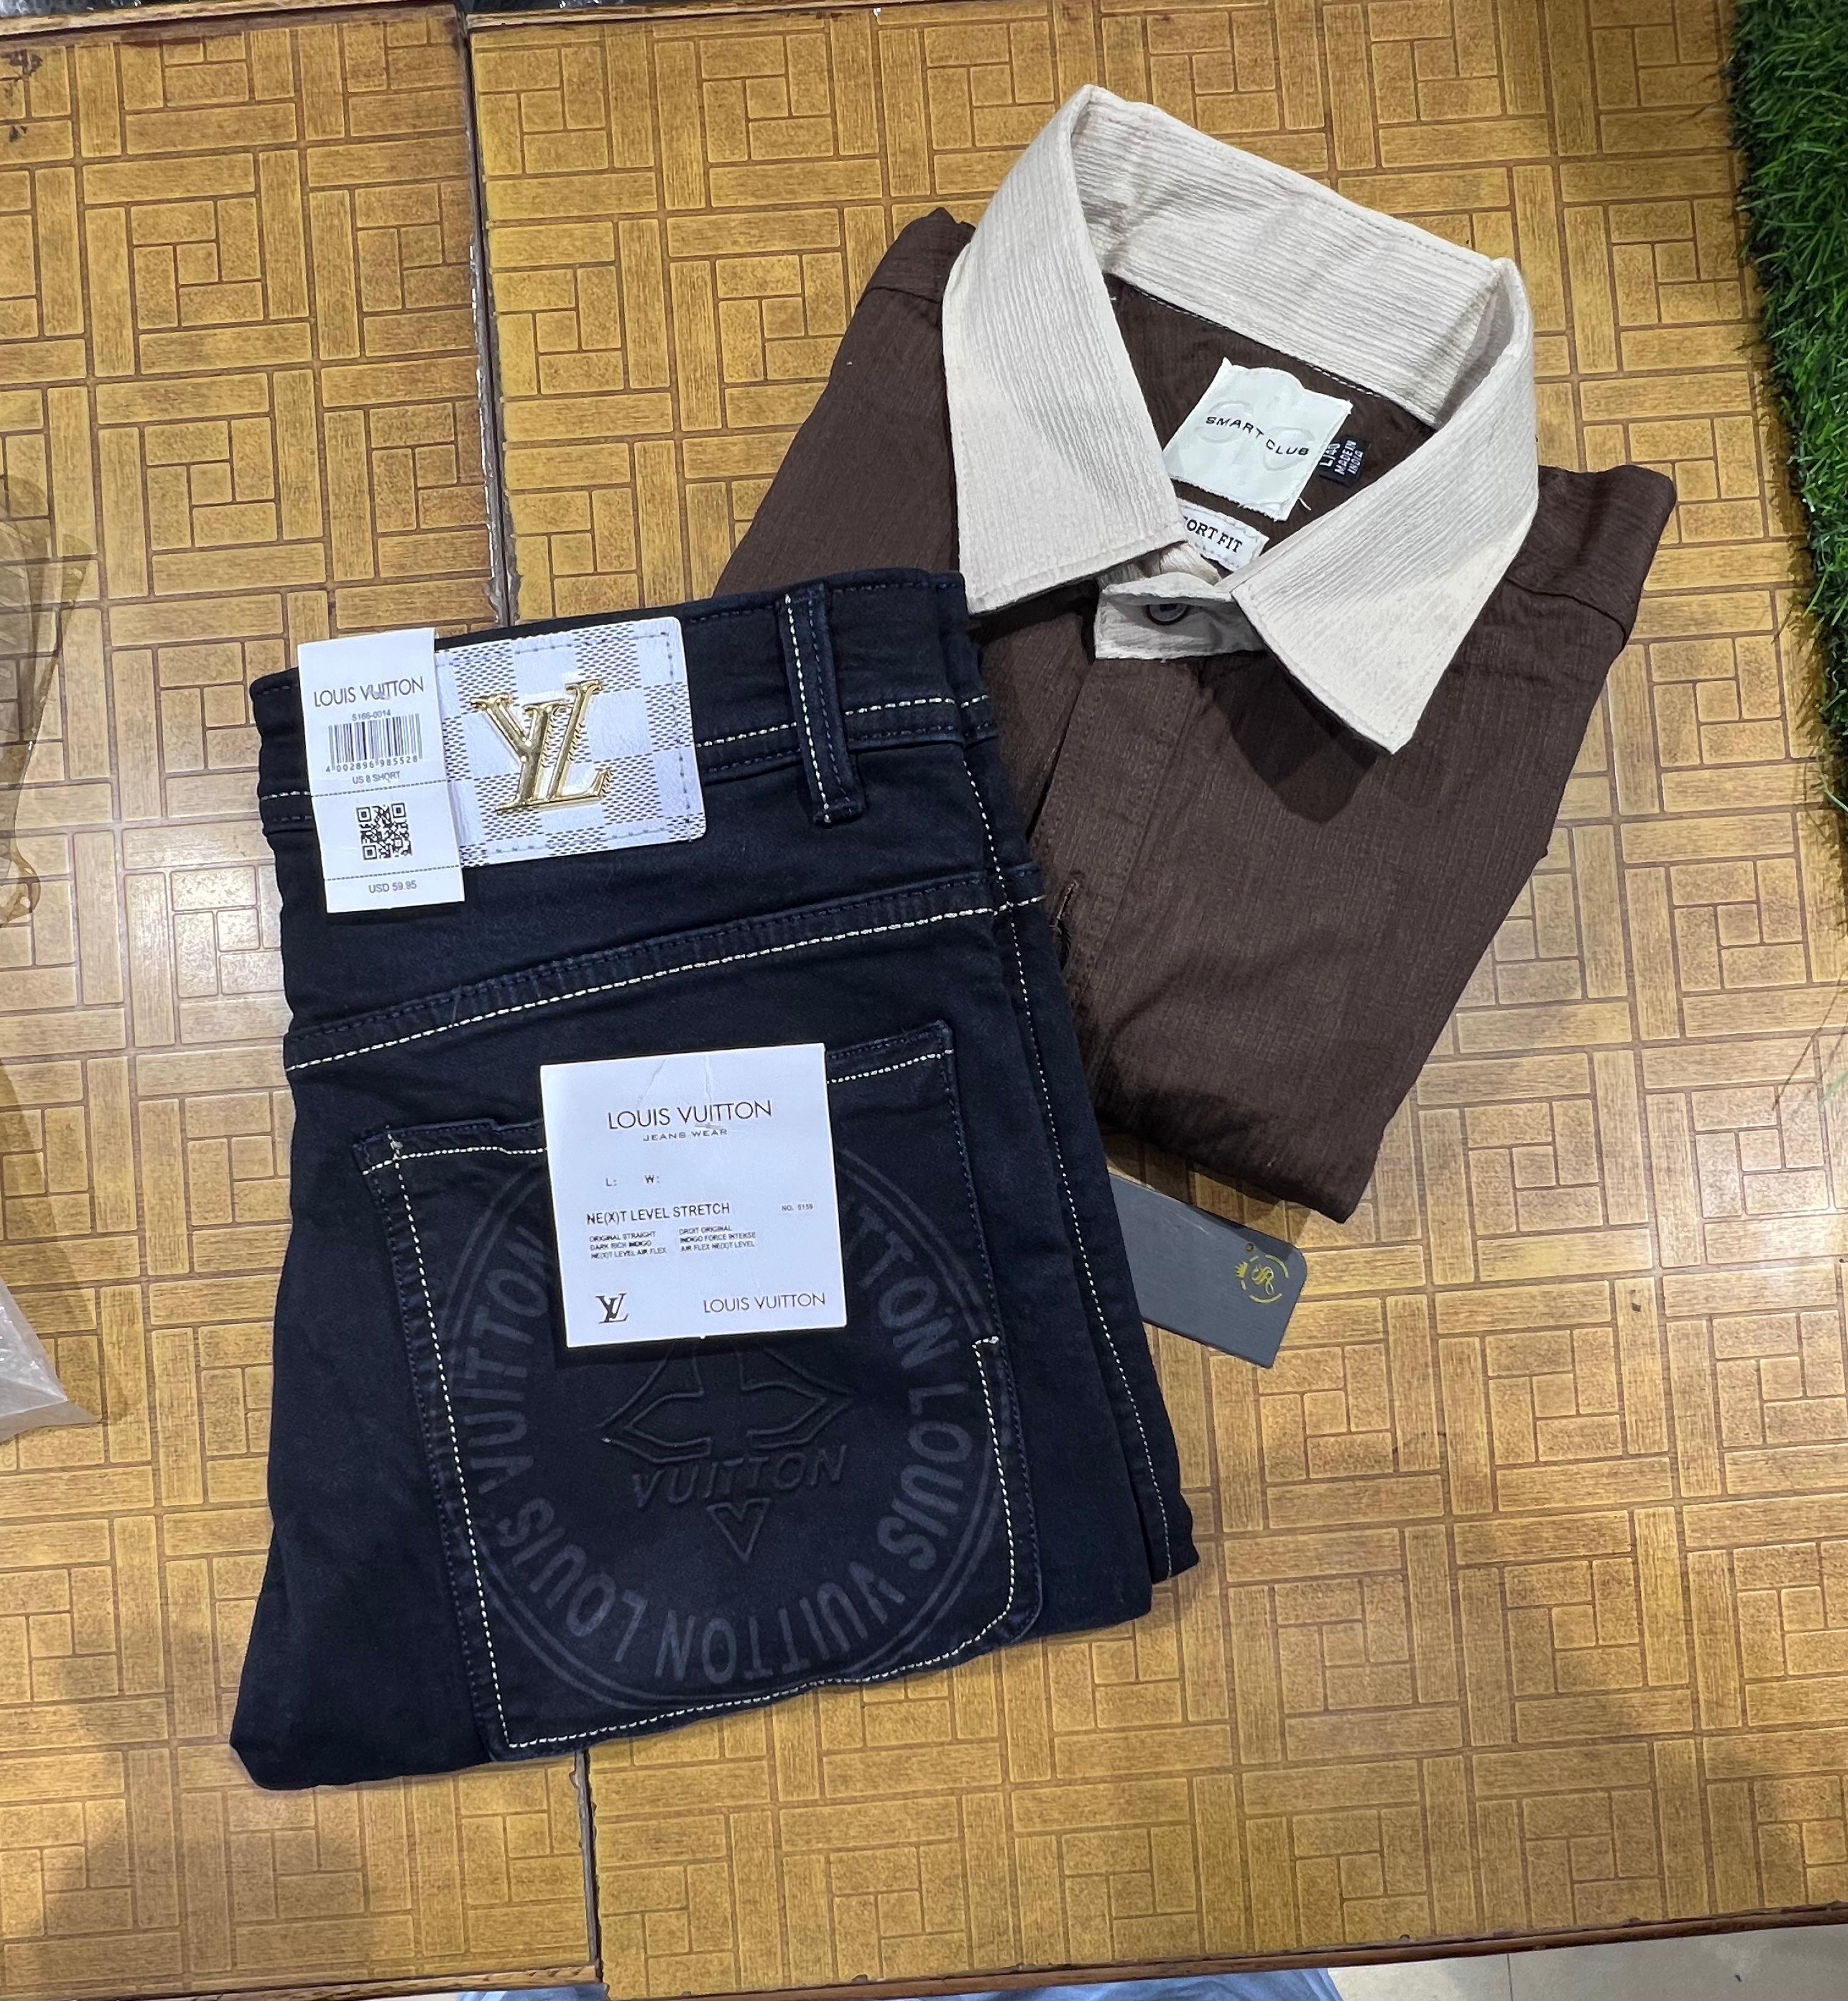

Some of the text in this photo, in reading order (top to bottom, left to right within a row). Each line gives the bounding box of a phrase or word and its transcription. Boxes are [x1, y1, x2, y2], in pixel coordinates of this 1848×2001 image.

[1206, 417, 1309, 456] SMART CLUB
[1335, 440, 1357, 475] MADE IN
[1347, 450, 1364, 474] INDIA
[1183, 516, 1242, 553] ORT FIT
[314, 676, 424, 707] LOUIS VUITTON
[352, 775, 364, 785] US
[369, 880, 417, 893] USD 59.95
[608, 1100, 772, 1130] LOUIS VUITTON
[643, 1129, 728, 1141] JEANS WEAR
[606, 1178, 617, 1187] L:
[645, 1174, 660, 1183] W:
[587, 1202, 730, 1226] NE(X)T LEVEL STRETCH
[622, 1231, 656, 1240] STRAIGHT
[841, 1194, 959, 1370] TTON
[703, 1292, 826, 1314] LOUIS VUITTON
[632, 1444, 847, 1509] VUITTON
[876, 1382, 972, 1571] LOUIS
[498, 1497, 647, 1663] LOUIS
[654, 1560, 905, 1684] VUITTON
